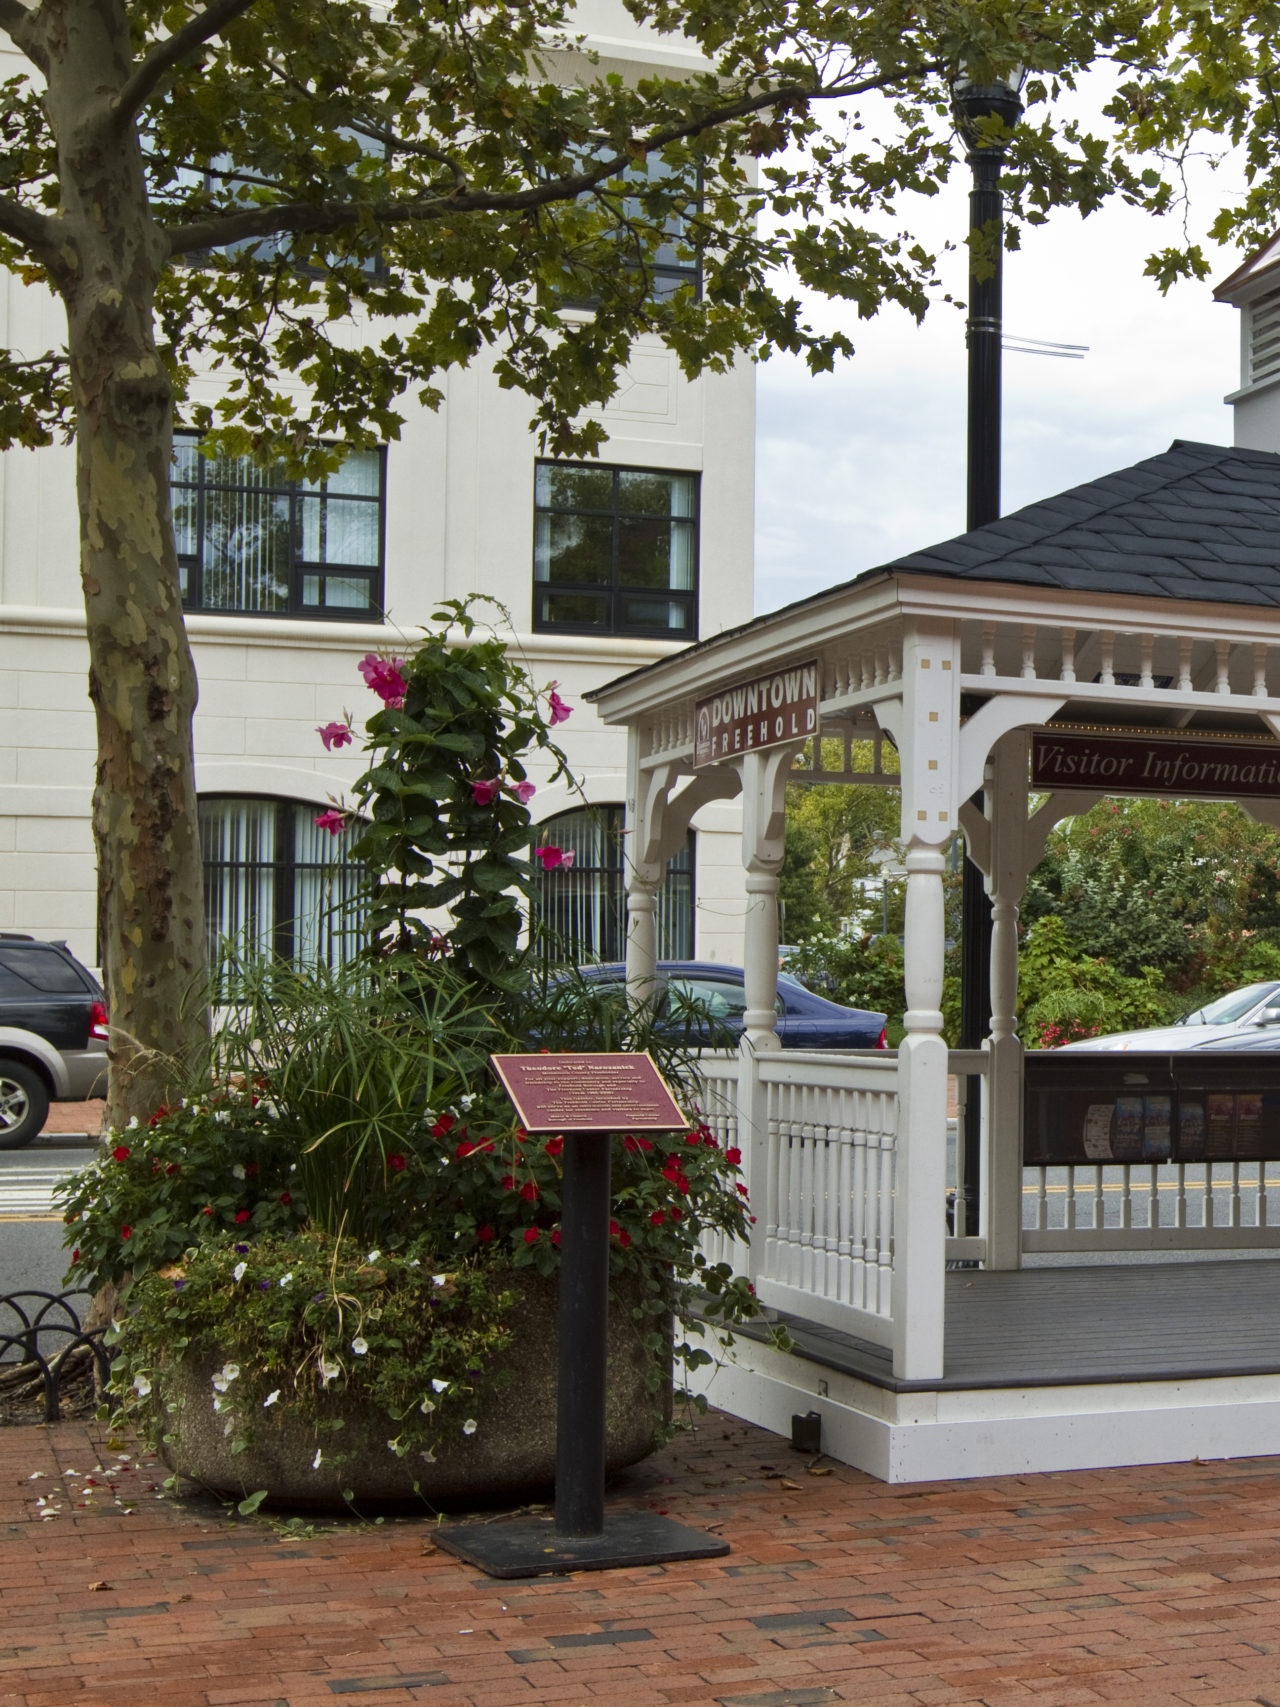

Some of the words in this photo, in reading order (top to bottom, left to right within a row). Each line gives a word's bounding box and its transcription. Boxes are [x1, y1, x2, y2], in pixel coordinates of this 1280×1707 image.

[711, 665, 816, 728] DOWNTOWN
[711, 708, 816, 757] FREEHOLD
[1037, 744, 1133, 776] Visitor
